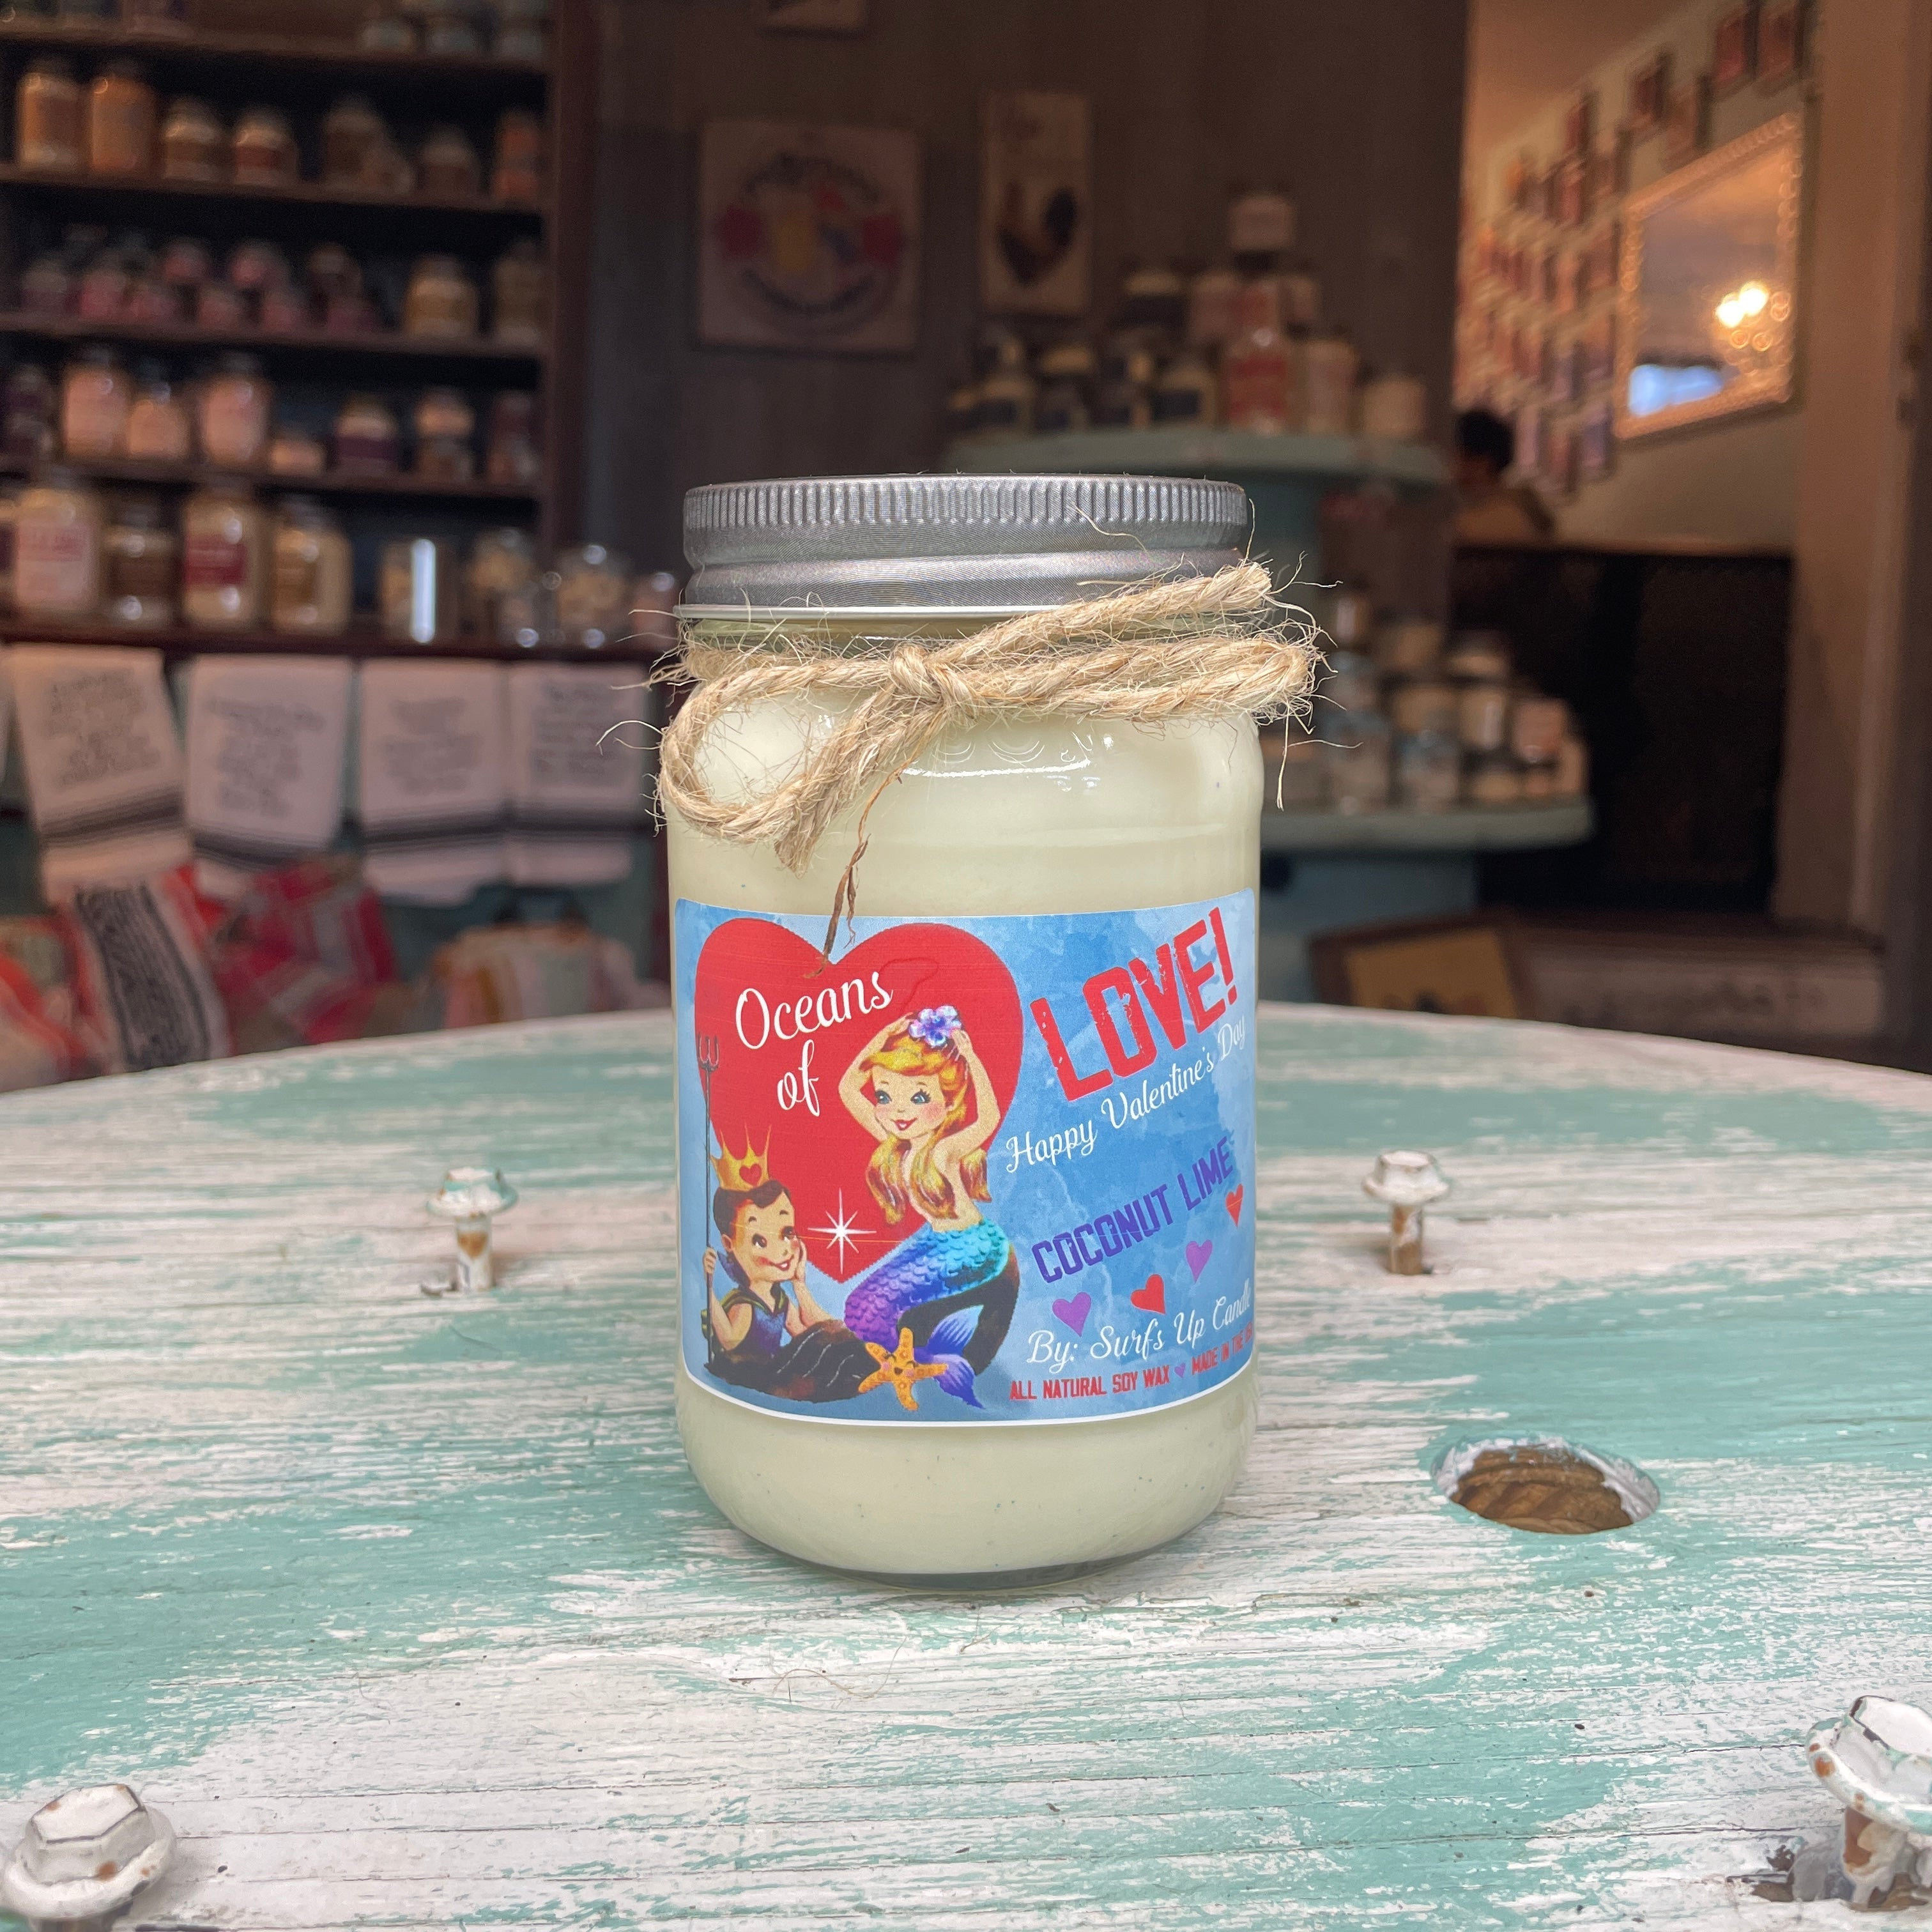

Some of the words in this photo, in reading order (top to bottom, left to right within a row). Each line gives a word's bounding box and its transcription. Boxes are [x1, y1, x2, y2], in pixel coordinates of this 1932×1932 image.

[736, 971, 893, 1049] Oceans
[1029, 907, 1238, 1101] LOVE!
[777, 1039, 820, 1117] of
[1006, 1120, 1098, 1173] Happy
[1101, 1046, 1214, 1129] Valentine's
[1217, 1015, 1246, 1061] Day
[1031, 1183, 1174, 1283] COCONUT
[1177, 1136, 1234, 1211] LIME
[1009, 1380, 1038, 1400] ALL
[1042, 1376, 1107, 1399] NATURAL
[1112, 1371, 1138, 1394] SOY
[1142, 1364, 1170, 1389] WAX
[1192, 1346, 1219, 1376] MADE
[1026, 1330, 1078, 1374] By:
[1174, 1310, 1207, 1349] Up
